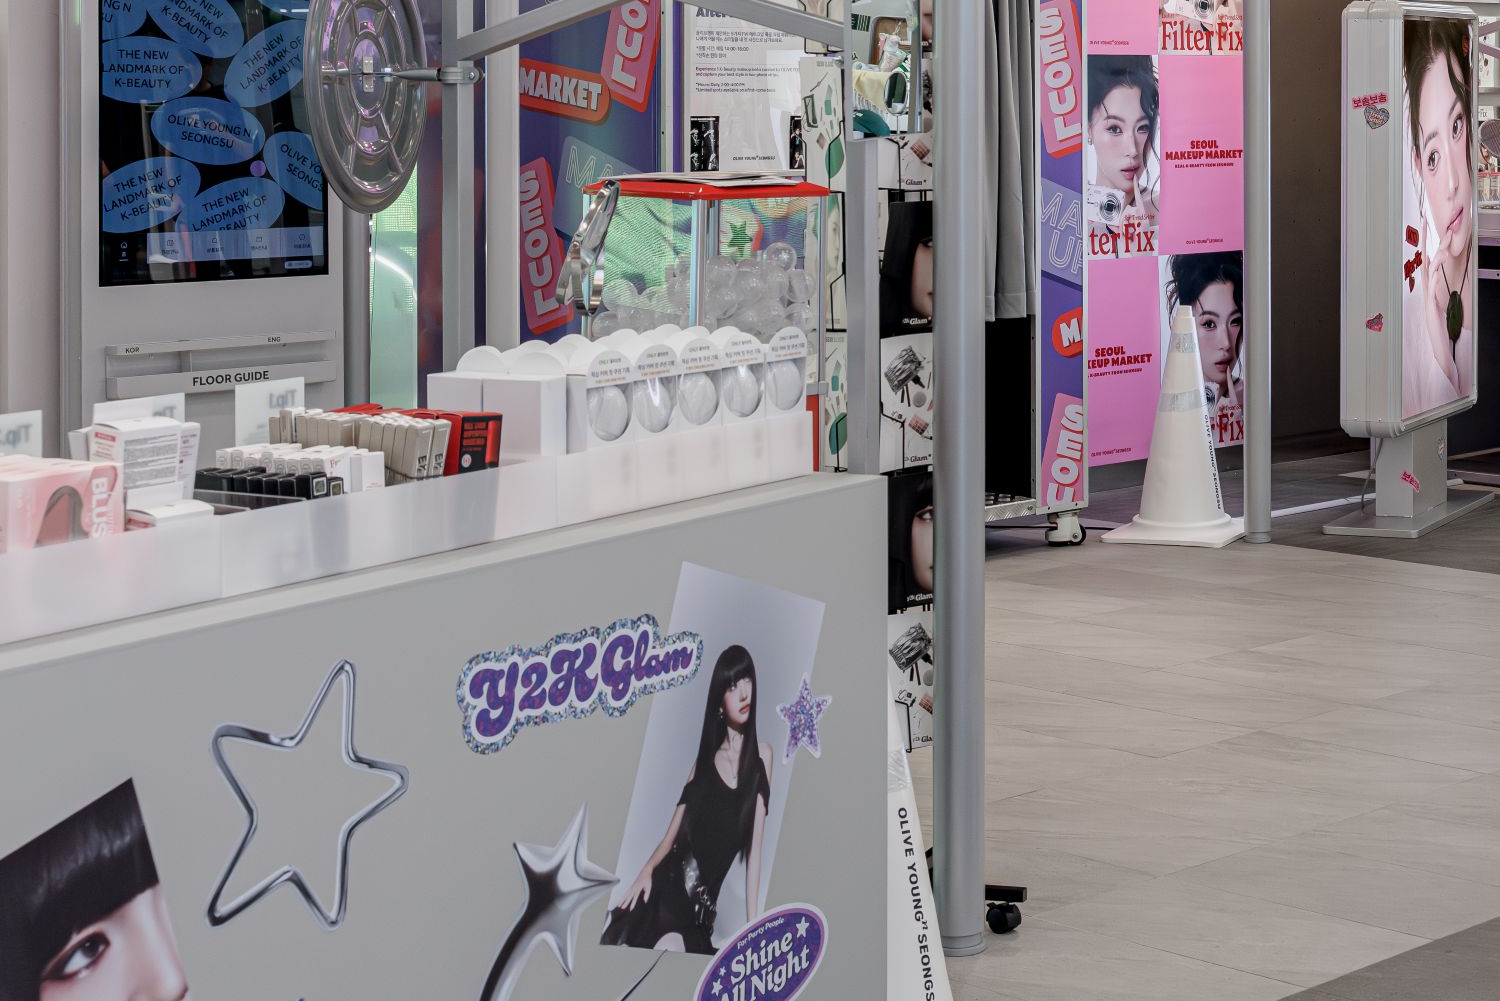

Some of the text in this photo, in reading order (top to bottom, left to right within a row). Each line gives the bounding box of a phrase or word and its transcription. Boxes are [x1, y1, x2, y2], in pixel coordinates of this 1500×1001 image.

[161, 6, 211, 44] K-BEAUTY
[213, 26, 229, 40] OF
[1161, 21, 1243, 51] Filter Fix
[119, 50, 169, 60] THE NEW
[243, 33, 284, 67] THE NEW
[102, 64, 184, 75] LANDMARK OF
[240, 47, 288, 90] LANDMARK
[1040, 7, 1083, 143] SEOUL
[114, 79, 171, 89] K-BEAUTY
[519, 66, 602, 112] MARKET
[167, 114, 199, 128] OLIVE
[201, 119, 241, 135] YOUNG
[181, 131, 234, 149] SEONGSU
[280, 143, 310, 166] OLIVE
[1190, 140, 1219, 150] SEOUL
[1165, 149, 1243, 161] MAKEUP MARKET
[104, 175, 183, 213] LANDMARK OF
[113, 168, 163, 193] THE NEW
[120, 194, 175, 222] K-BEAUTY
[192, 195, 268, 232] LANDMARK OF
[202, 187, 250, 213] THE NEW
[519, 170, 560, 316] SEOUL
[1124, 222, 1155, 253] Fix
[910, 317, 928, 325] Glam
[1095, 346, 1126, 358] SEOUL
[1111, 353, 1152, 367] MARKET
[192, 370, 270, 387] FLOOR GUIDE
[1218, 411, 1244, 443] Fix
[469, 629, 694, 737] Y2K Glam
[897, 807, 915, 857] OLIVE
[737, 916, 785, 950] For Party People
[730, 930, 794, 985] Shine
[750, 944, 811, 998] Night
